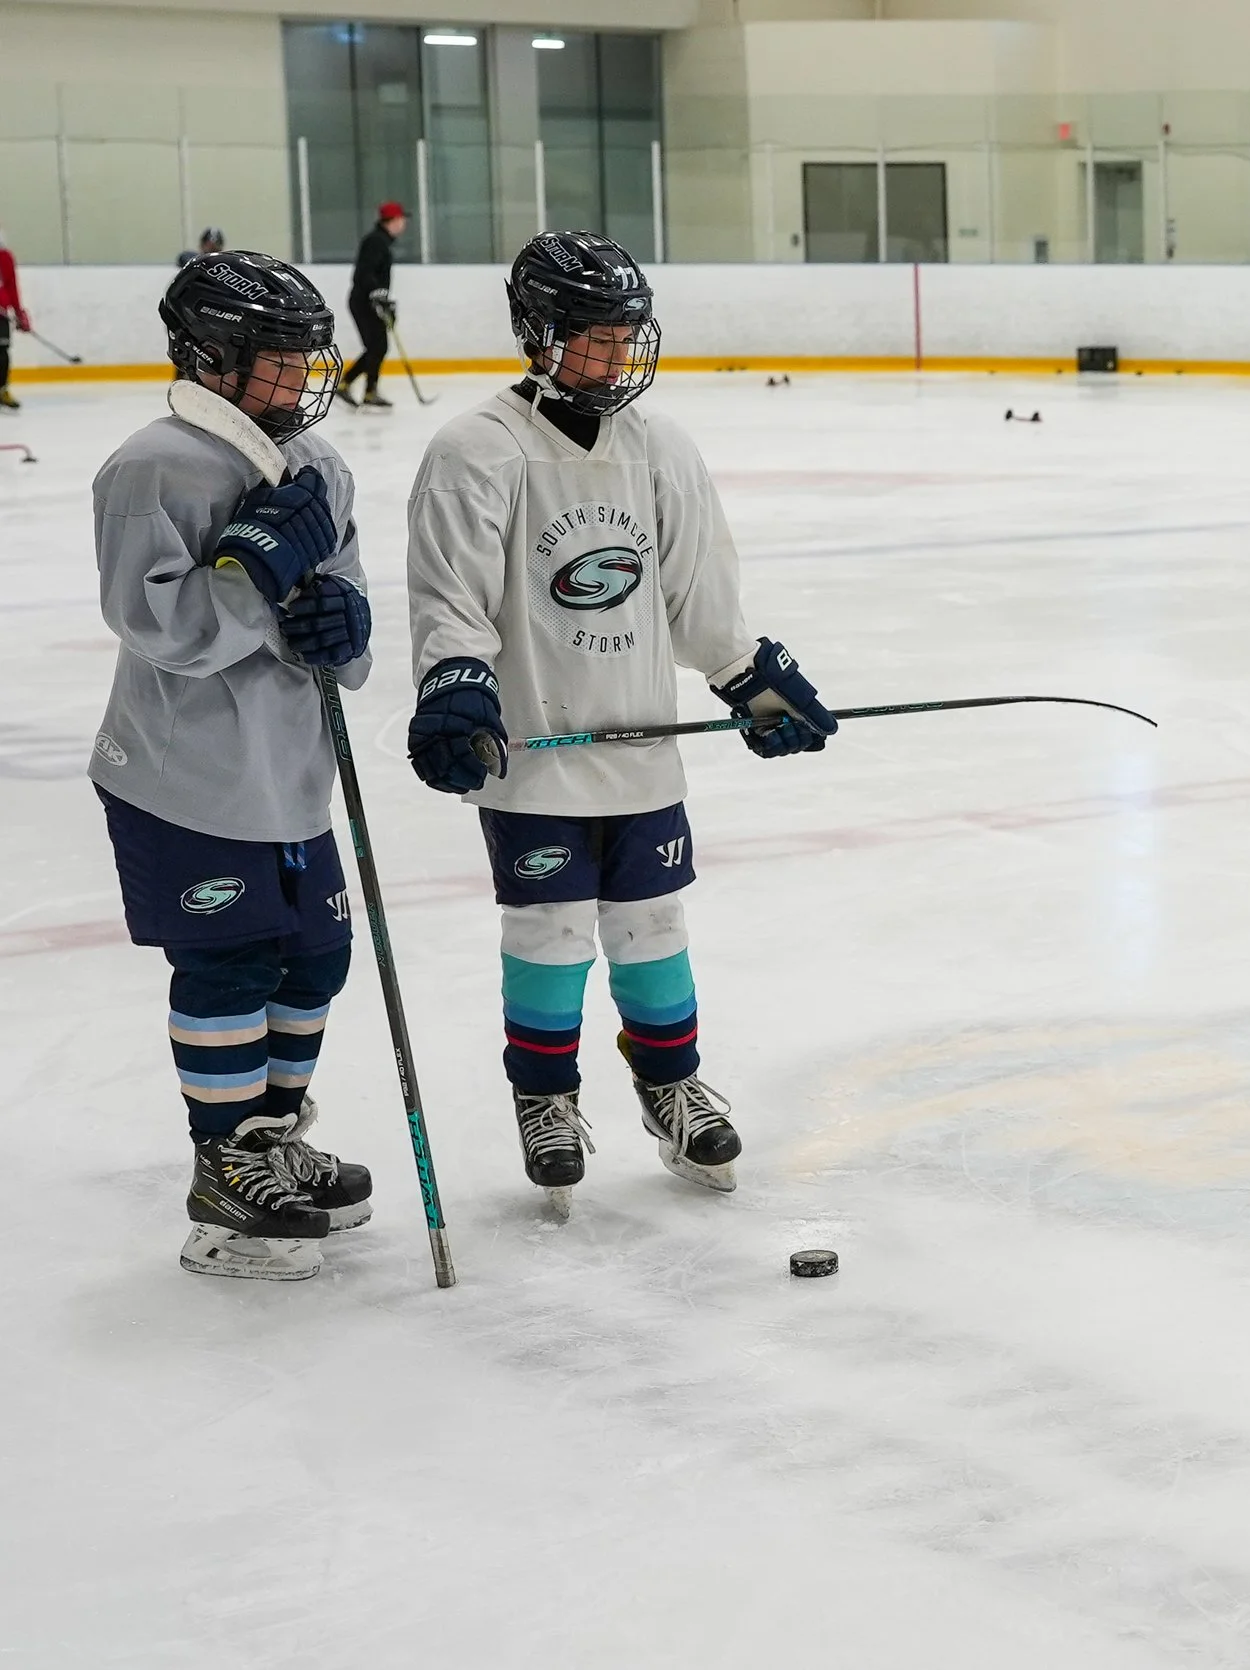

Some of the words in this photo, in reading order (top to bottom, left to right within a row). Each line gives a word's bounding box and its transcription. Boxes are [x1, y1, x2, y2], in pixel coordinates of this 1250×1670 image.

[538, 236, 584, 273] STORM
[206, 262, 270, 301] STORM
[526, 278, 560, 297] BAUER
[612, 265, 641, 292] 77
[200, 305, 244, 324] BAUER
[536, 507, 587, 557] SOUTH
[597, 506, 654, 559] SIMCOE
[572, 629, 636, 653] STORM
[419, 668, 500, 702] BAUE
[408, 1111, 436, 1225] TWITCH
[218, 1199, 248, 1221] BAUER
